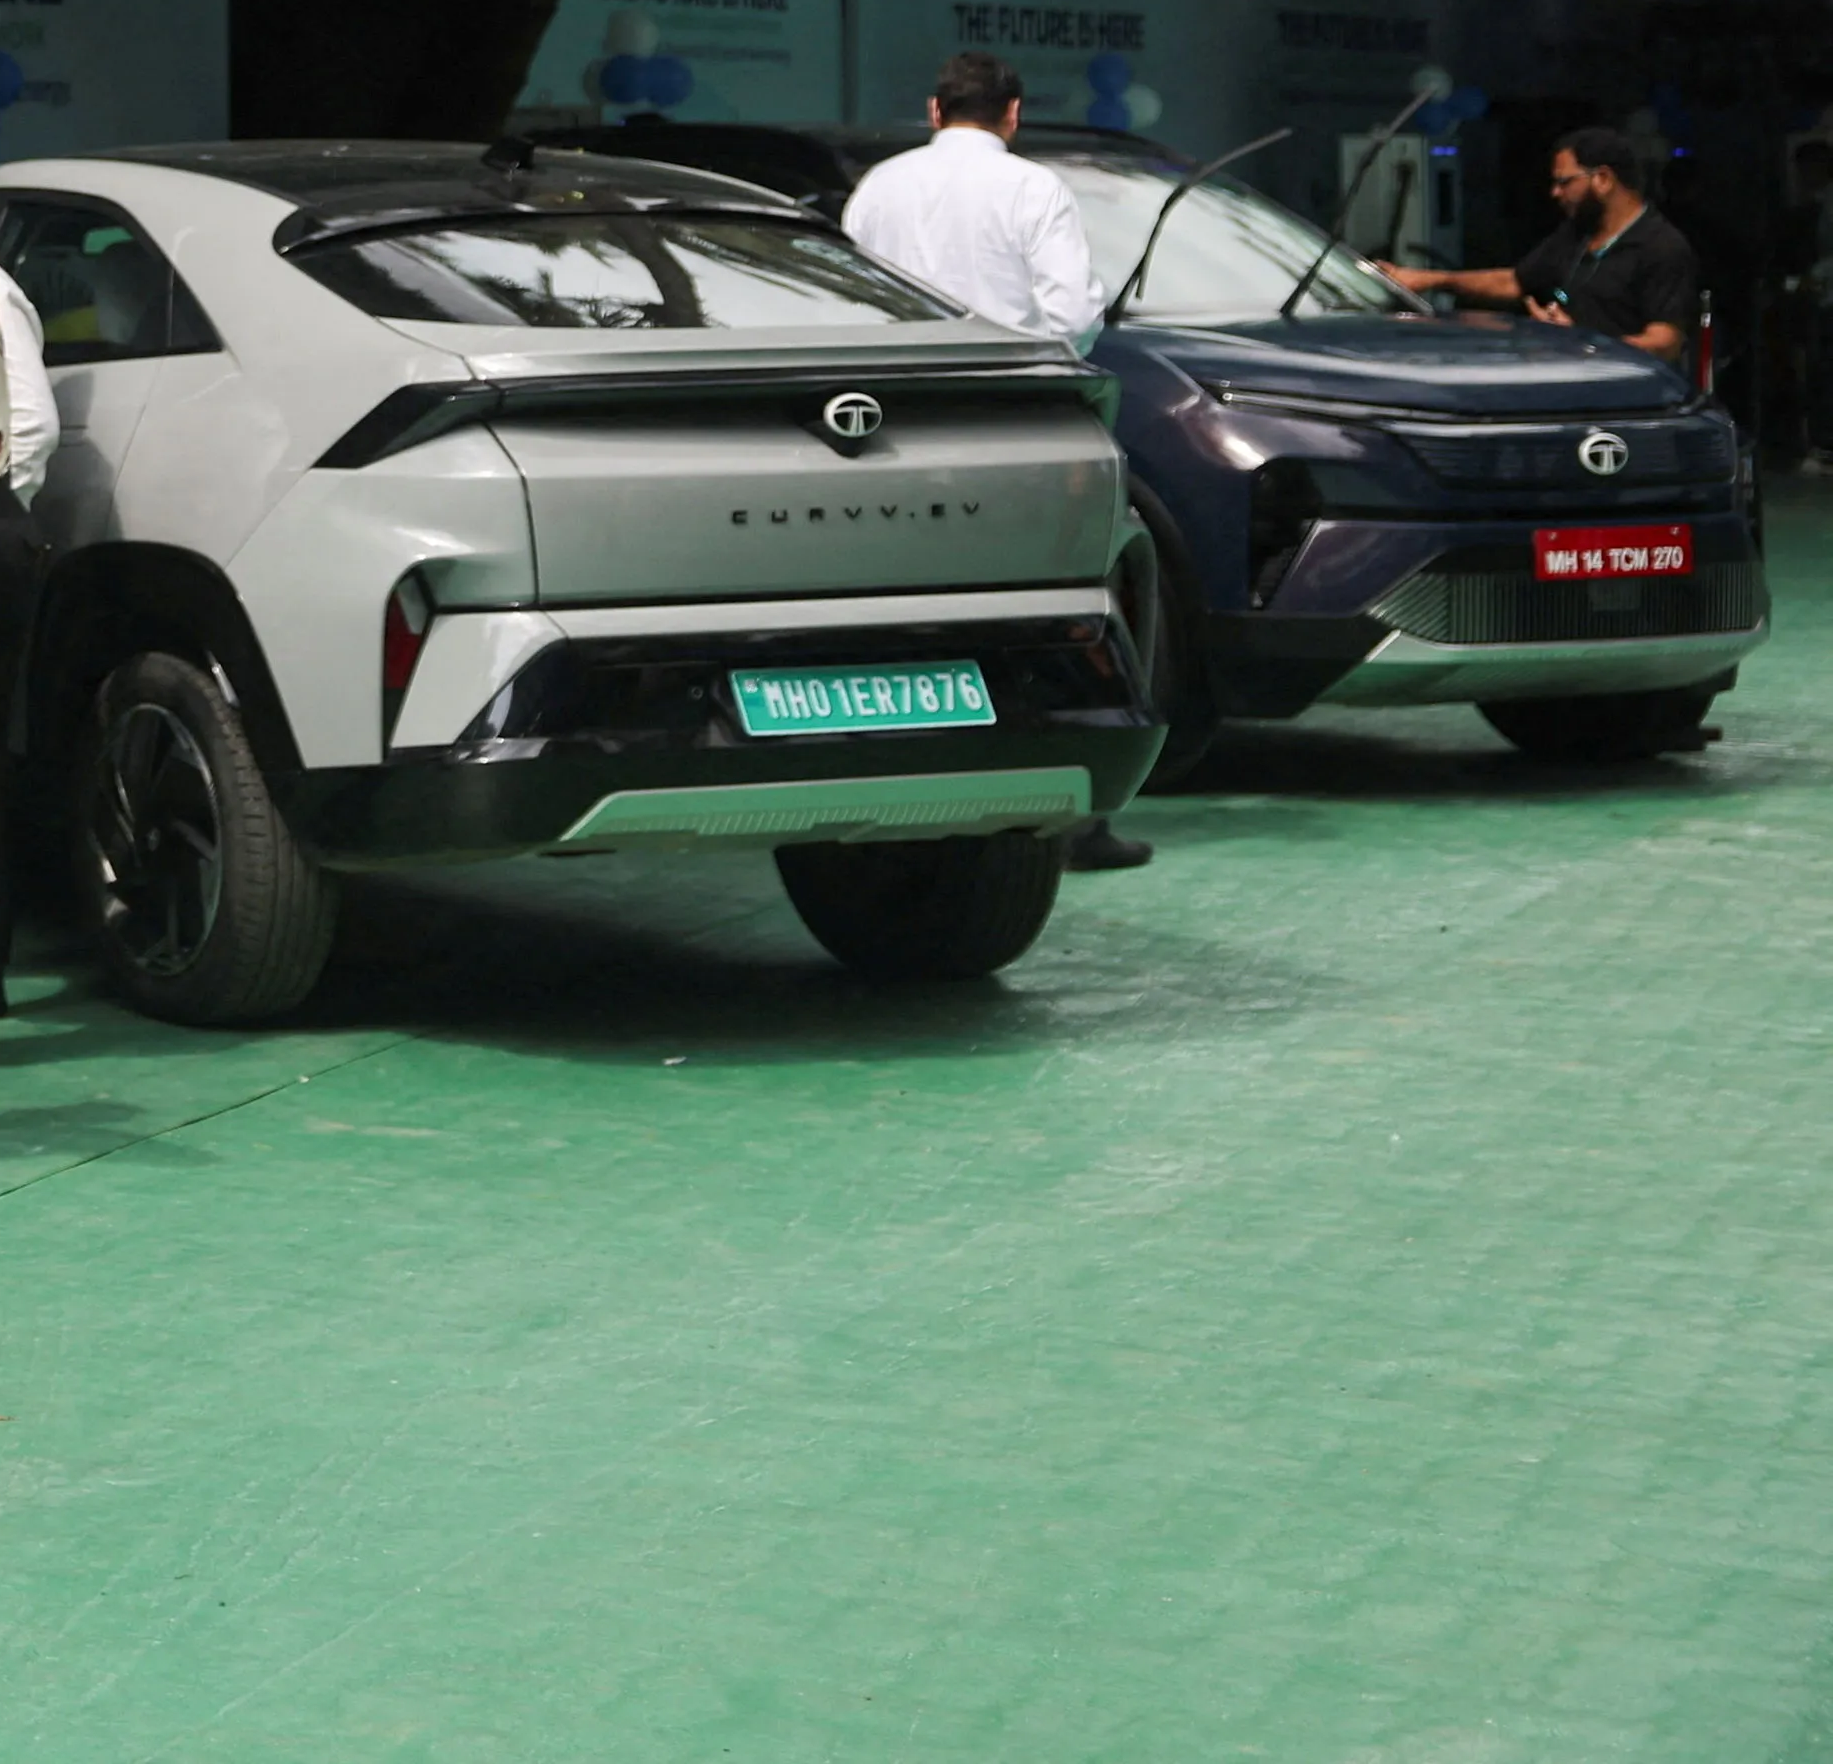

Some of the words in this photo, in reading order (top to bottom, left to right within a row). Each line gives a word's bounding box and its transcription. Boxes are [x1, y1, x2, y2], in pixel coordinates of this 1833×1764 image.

[952, 2, 991, 44] THE
[997, 4, 1075, 49] FUTURE
[1099, 12, 1146, 51] HERE
[1544, 548, 1580, 574] MH
[1582, 548, 1604, 572] 14
[1607, 547, 1649, 572] TCM
[1651, 545, 1684, 570] 270
[762, 672, 983, 720] MH01ER7876
